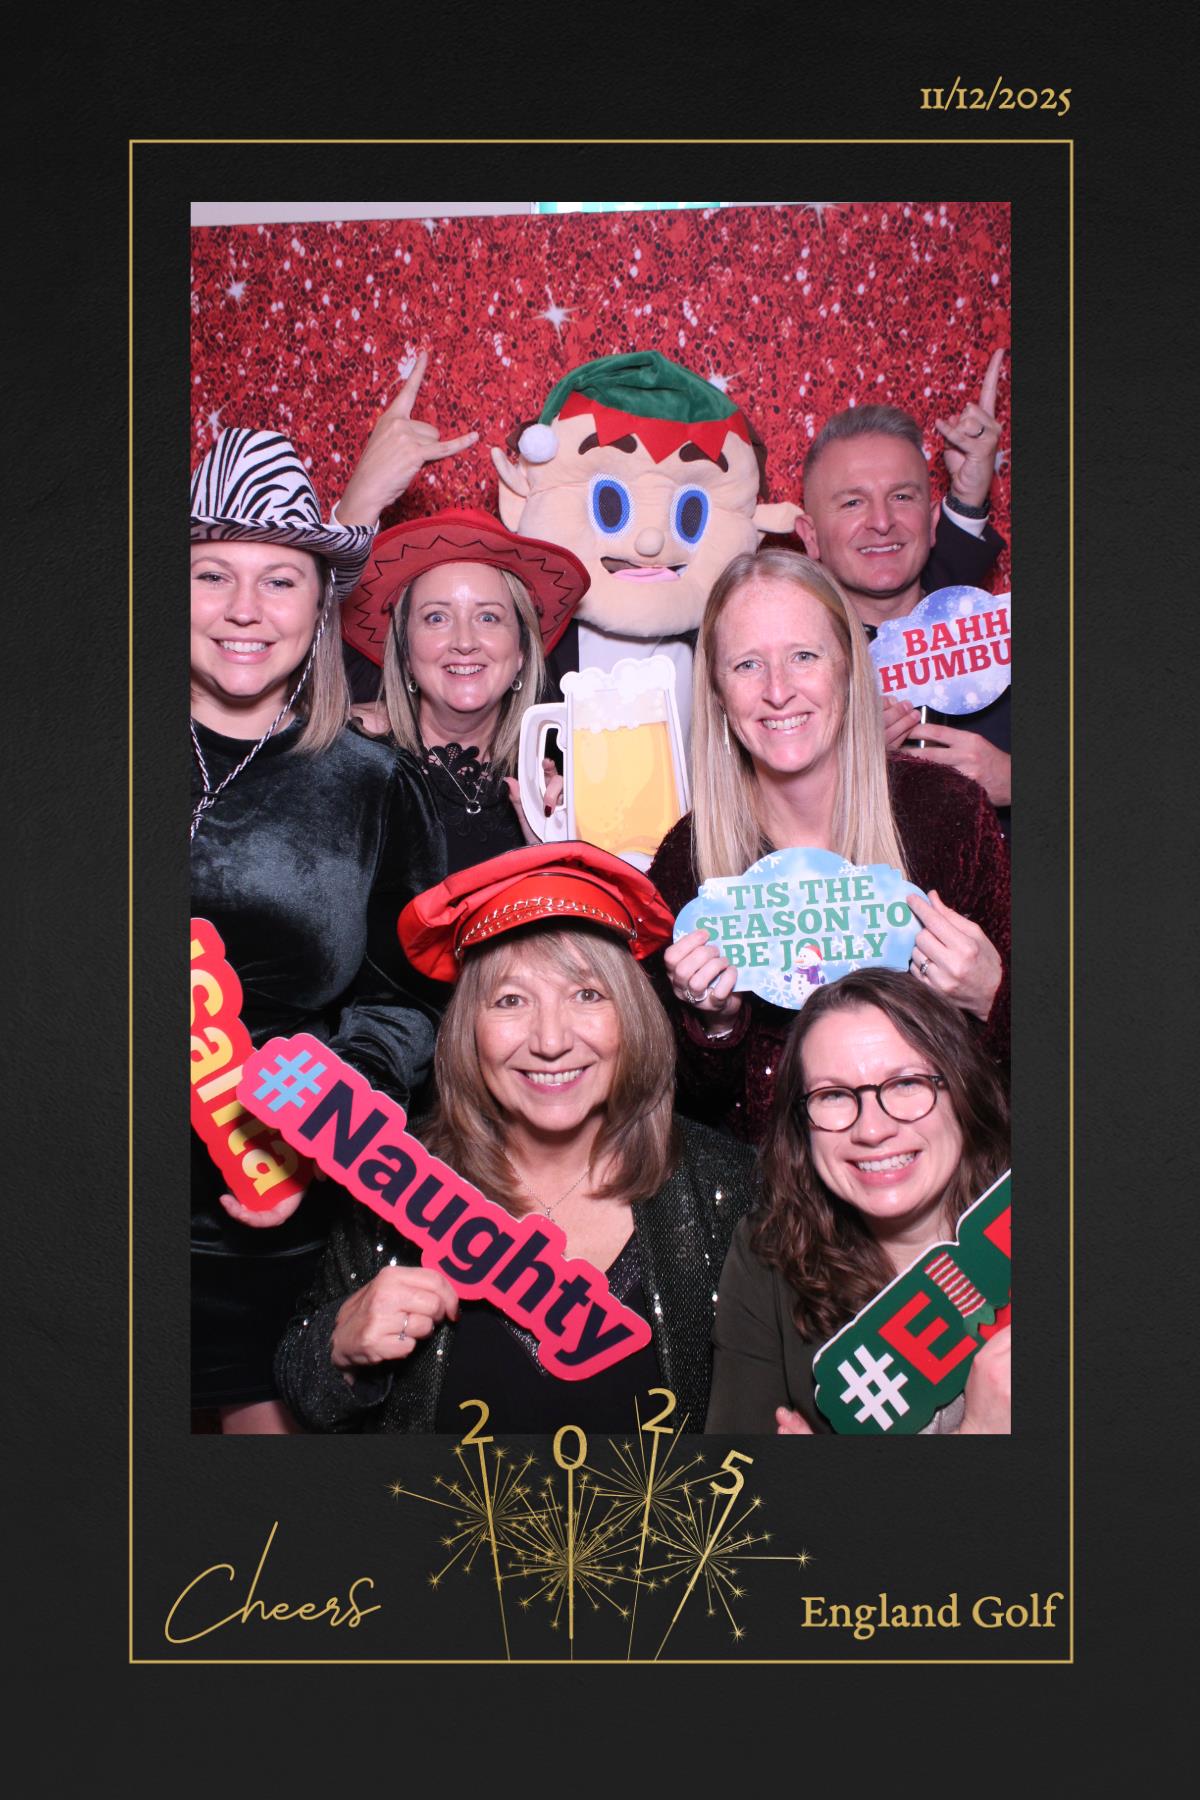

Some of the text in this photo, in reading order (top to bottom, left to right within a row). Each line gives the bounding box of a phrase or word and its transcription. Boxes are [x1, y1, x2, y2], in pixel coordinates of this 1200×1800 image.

[902, 608, 1011, 658] BAHH
[726, 875, 875, 911] TIS THE
[695, 901, 912, 942] SEASON TO
[722, 941, 770, 969] BE
[251, 1049, 635, 1367] #Naughty
